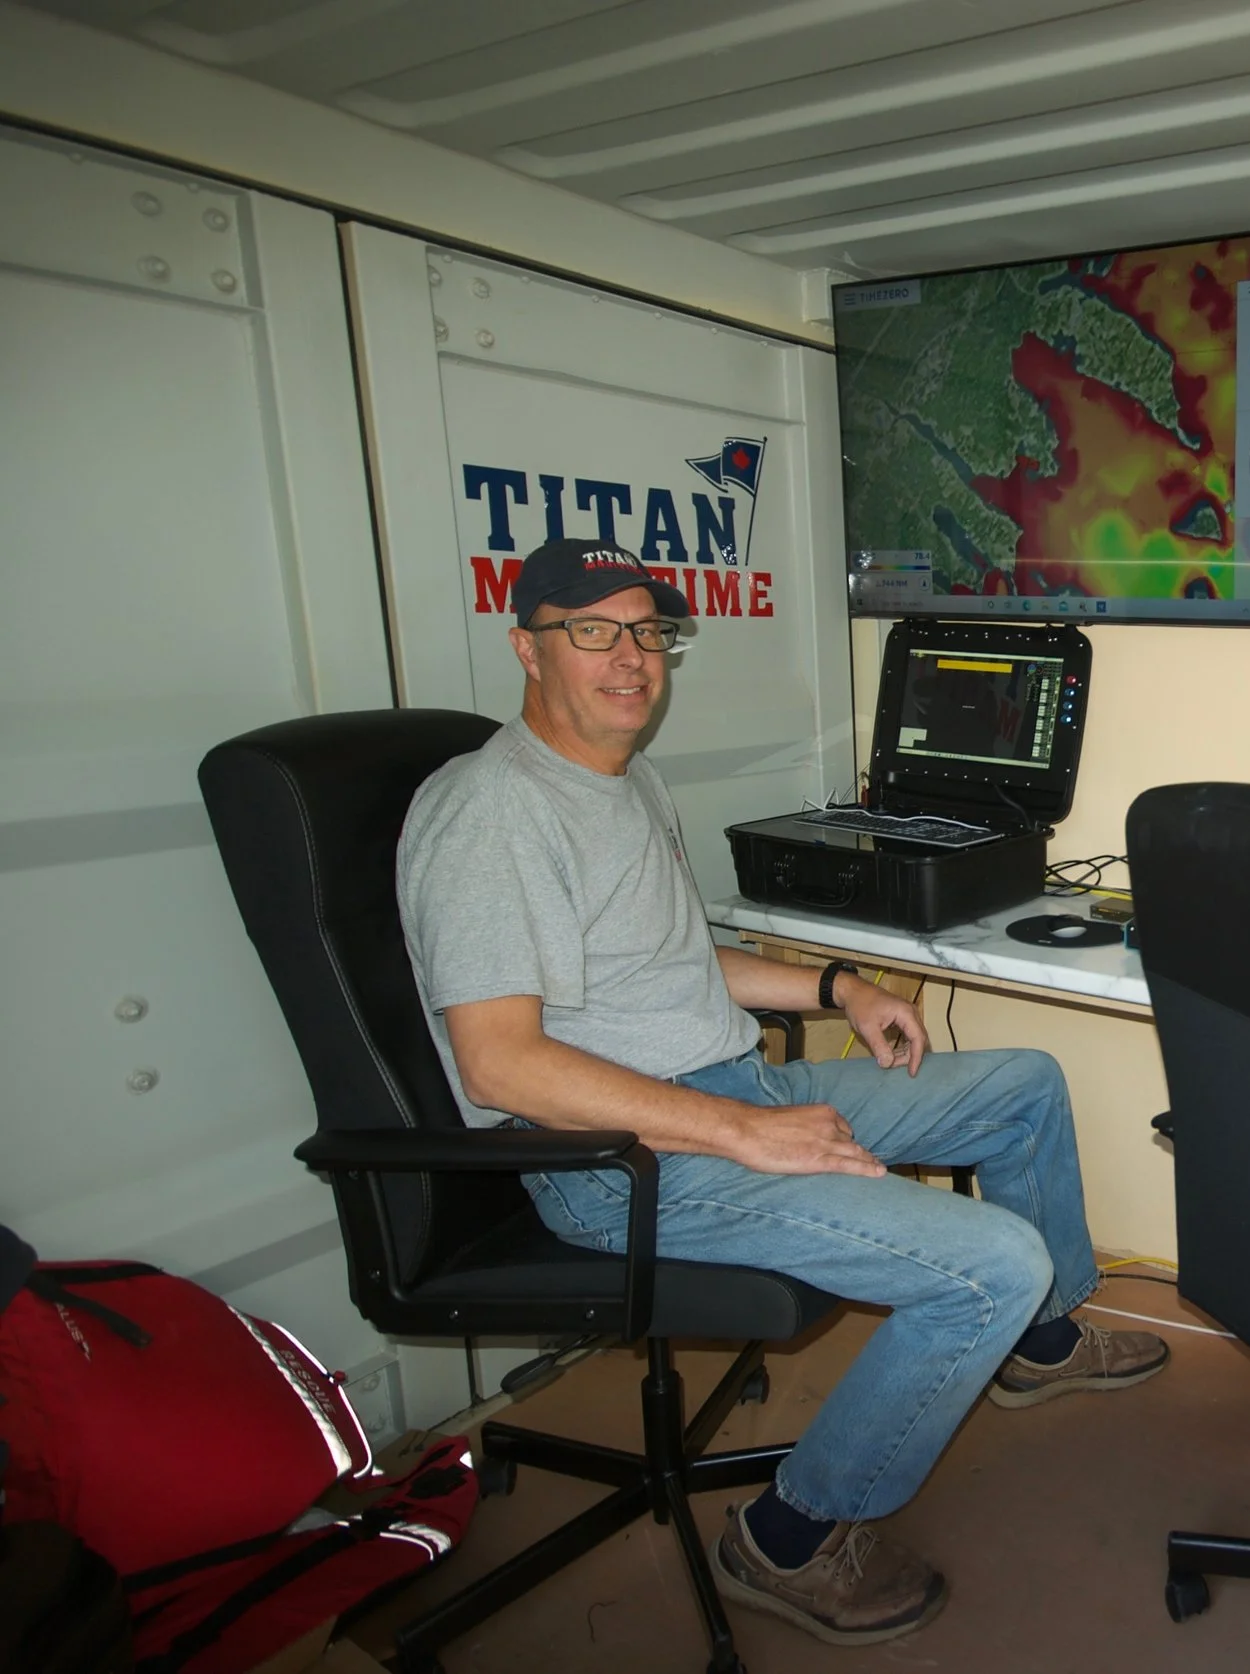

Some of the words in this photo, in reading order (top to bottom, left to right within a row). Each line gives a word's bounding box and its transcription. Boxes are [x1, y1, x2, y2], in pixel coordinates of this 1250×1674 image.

[860, 288, 909, 303] TIMEZERO
[463, 464, 737, 565] TITAN
[470, 557, 774, 617] MIME
